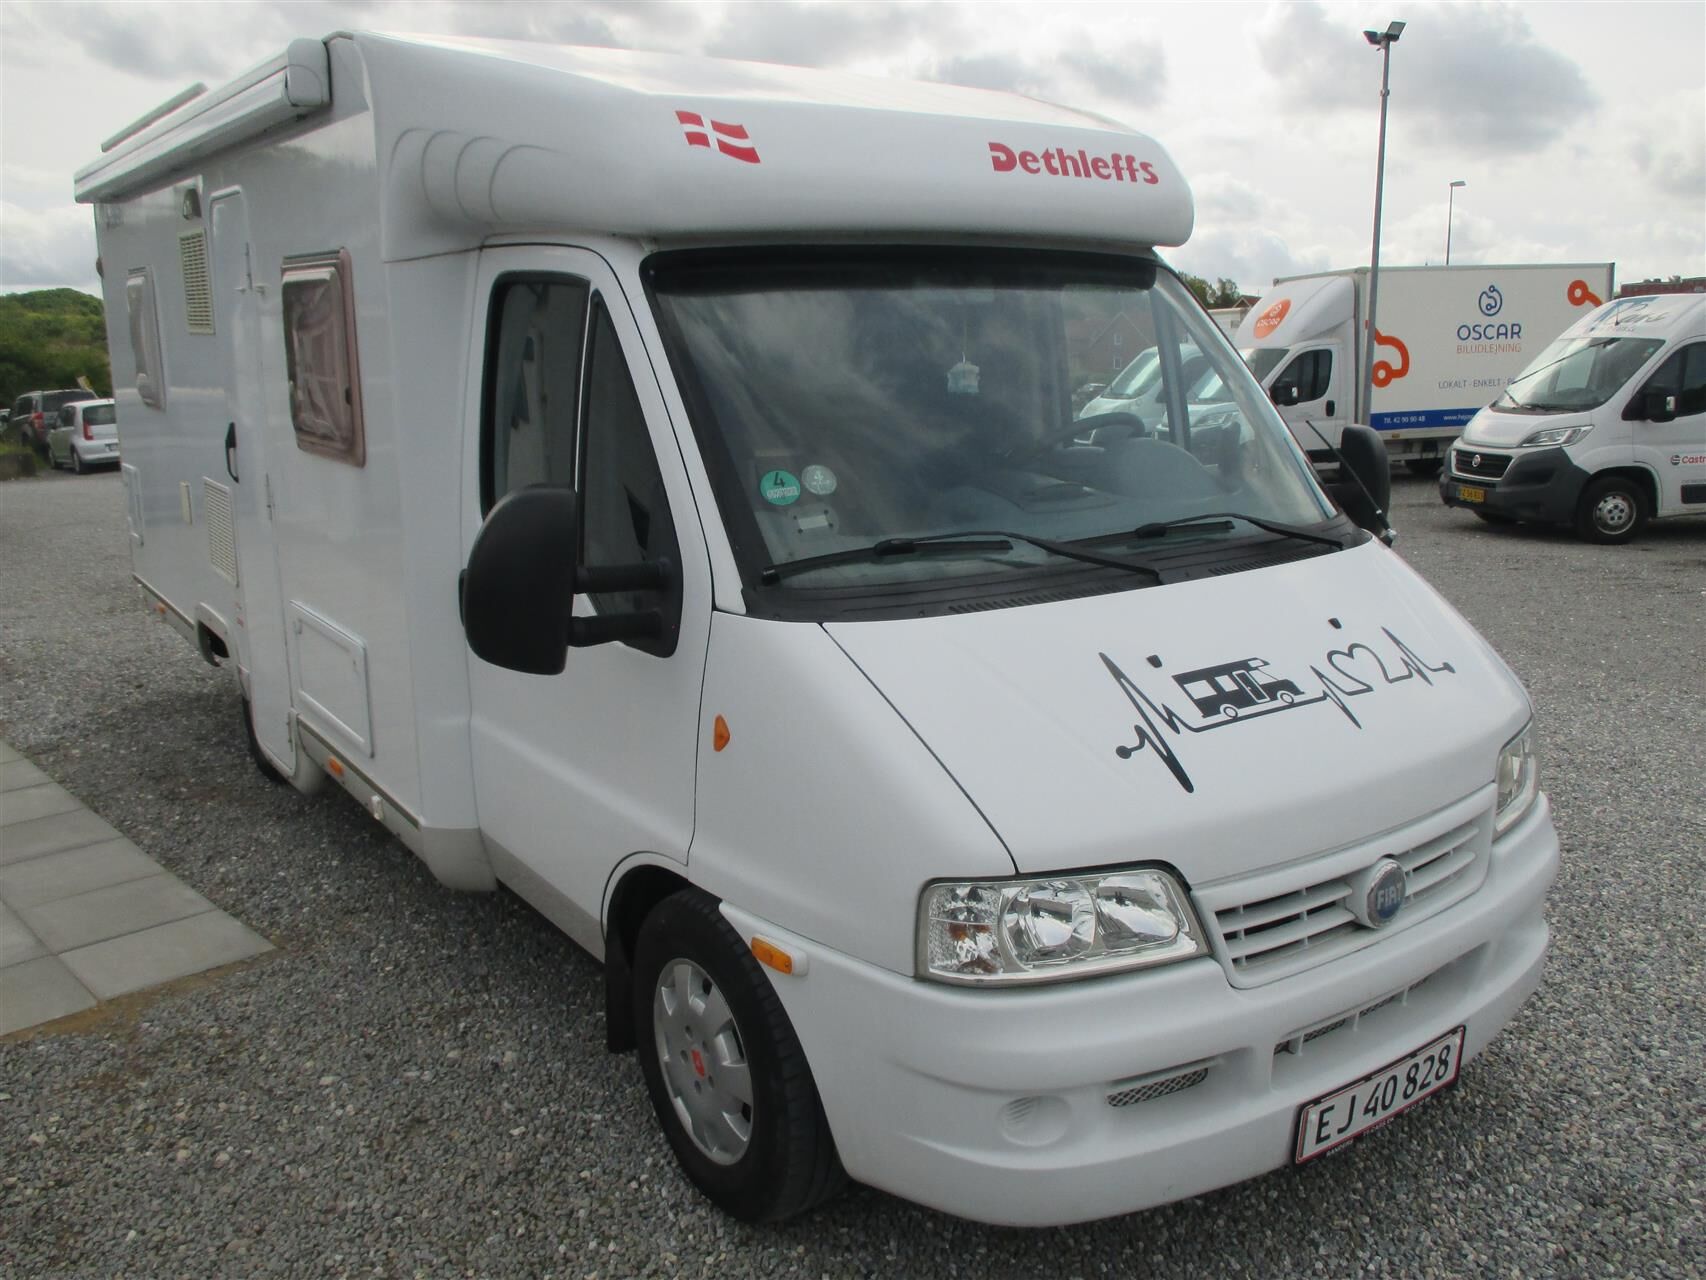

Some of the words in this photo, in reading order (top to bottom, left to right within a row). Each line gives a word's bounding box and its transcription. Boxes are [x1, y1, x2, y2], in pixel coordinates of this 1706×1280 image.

[988, 142, 1160, 185] Dethleffs
[1457, 323, 1522, 341] OSCAR
[1456, 343, 1522, 354] BILUDLEJNING
[1438, 379, 1466, 389] LOKALT
[1473, 378, 1502, 388] ENKELT
[773, 472, 786, 488] 4
[1316, 1095, 1357, 1144] EJ
[1363, 1075, 1398, 1118] 40
[1403, 1044, 1451, 1100] 828
